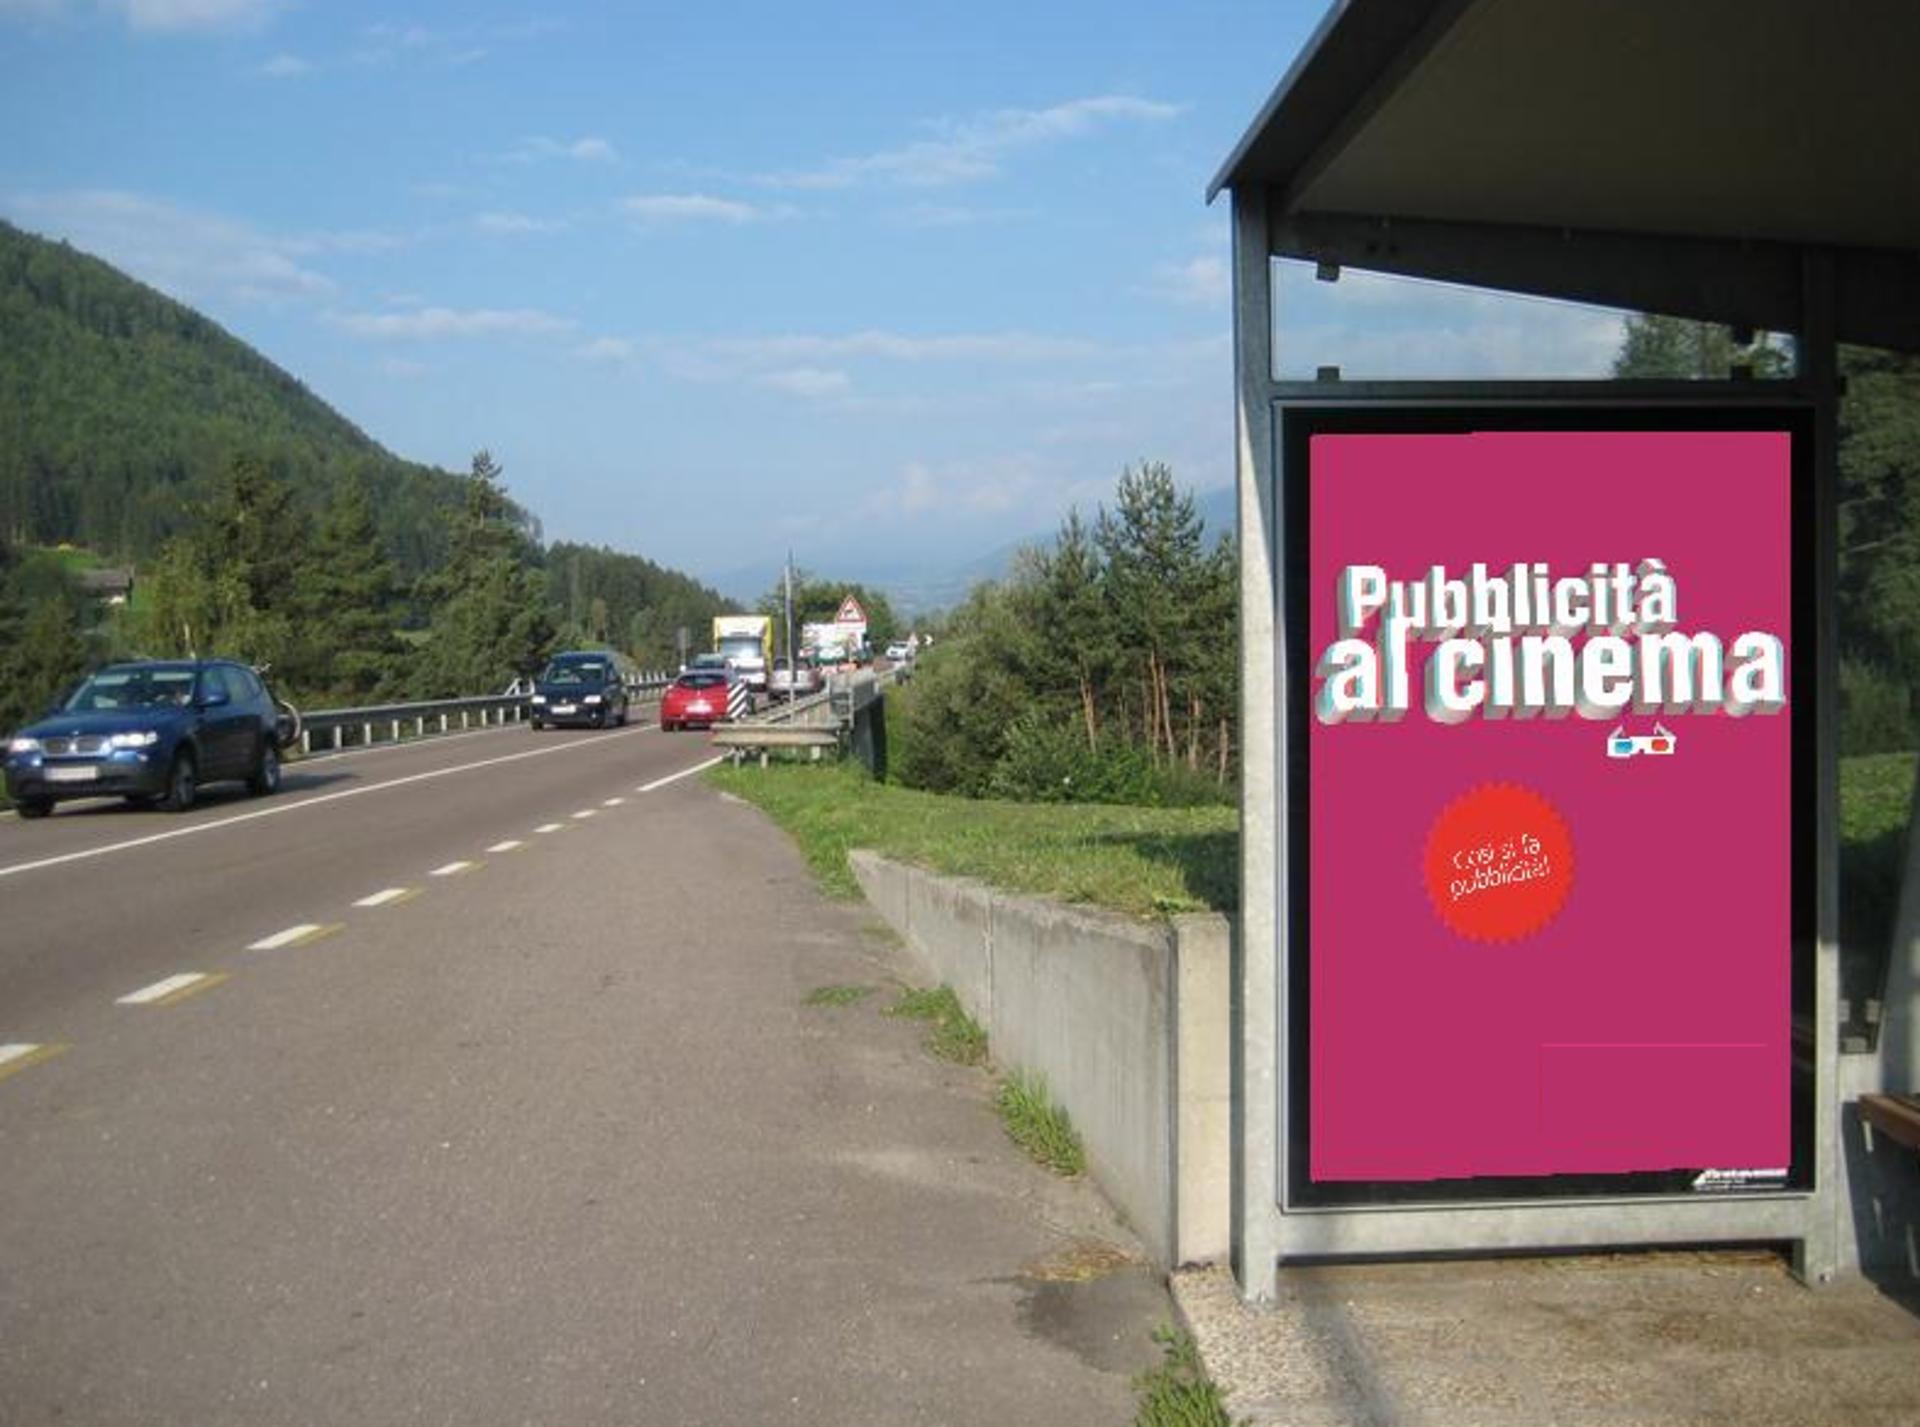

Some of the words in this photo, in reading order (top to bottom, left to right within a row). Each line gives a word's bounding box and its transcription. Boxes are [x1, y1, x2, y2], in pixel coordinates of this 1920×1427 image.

[1340, 559, 1677, 637] Pubblicità
[1316, 615, 1410, 723] al
[1425, 618, 1787, 723] cinema
[1521, 833, 1541, 854] fa
